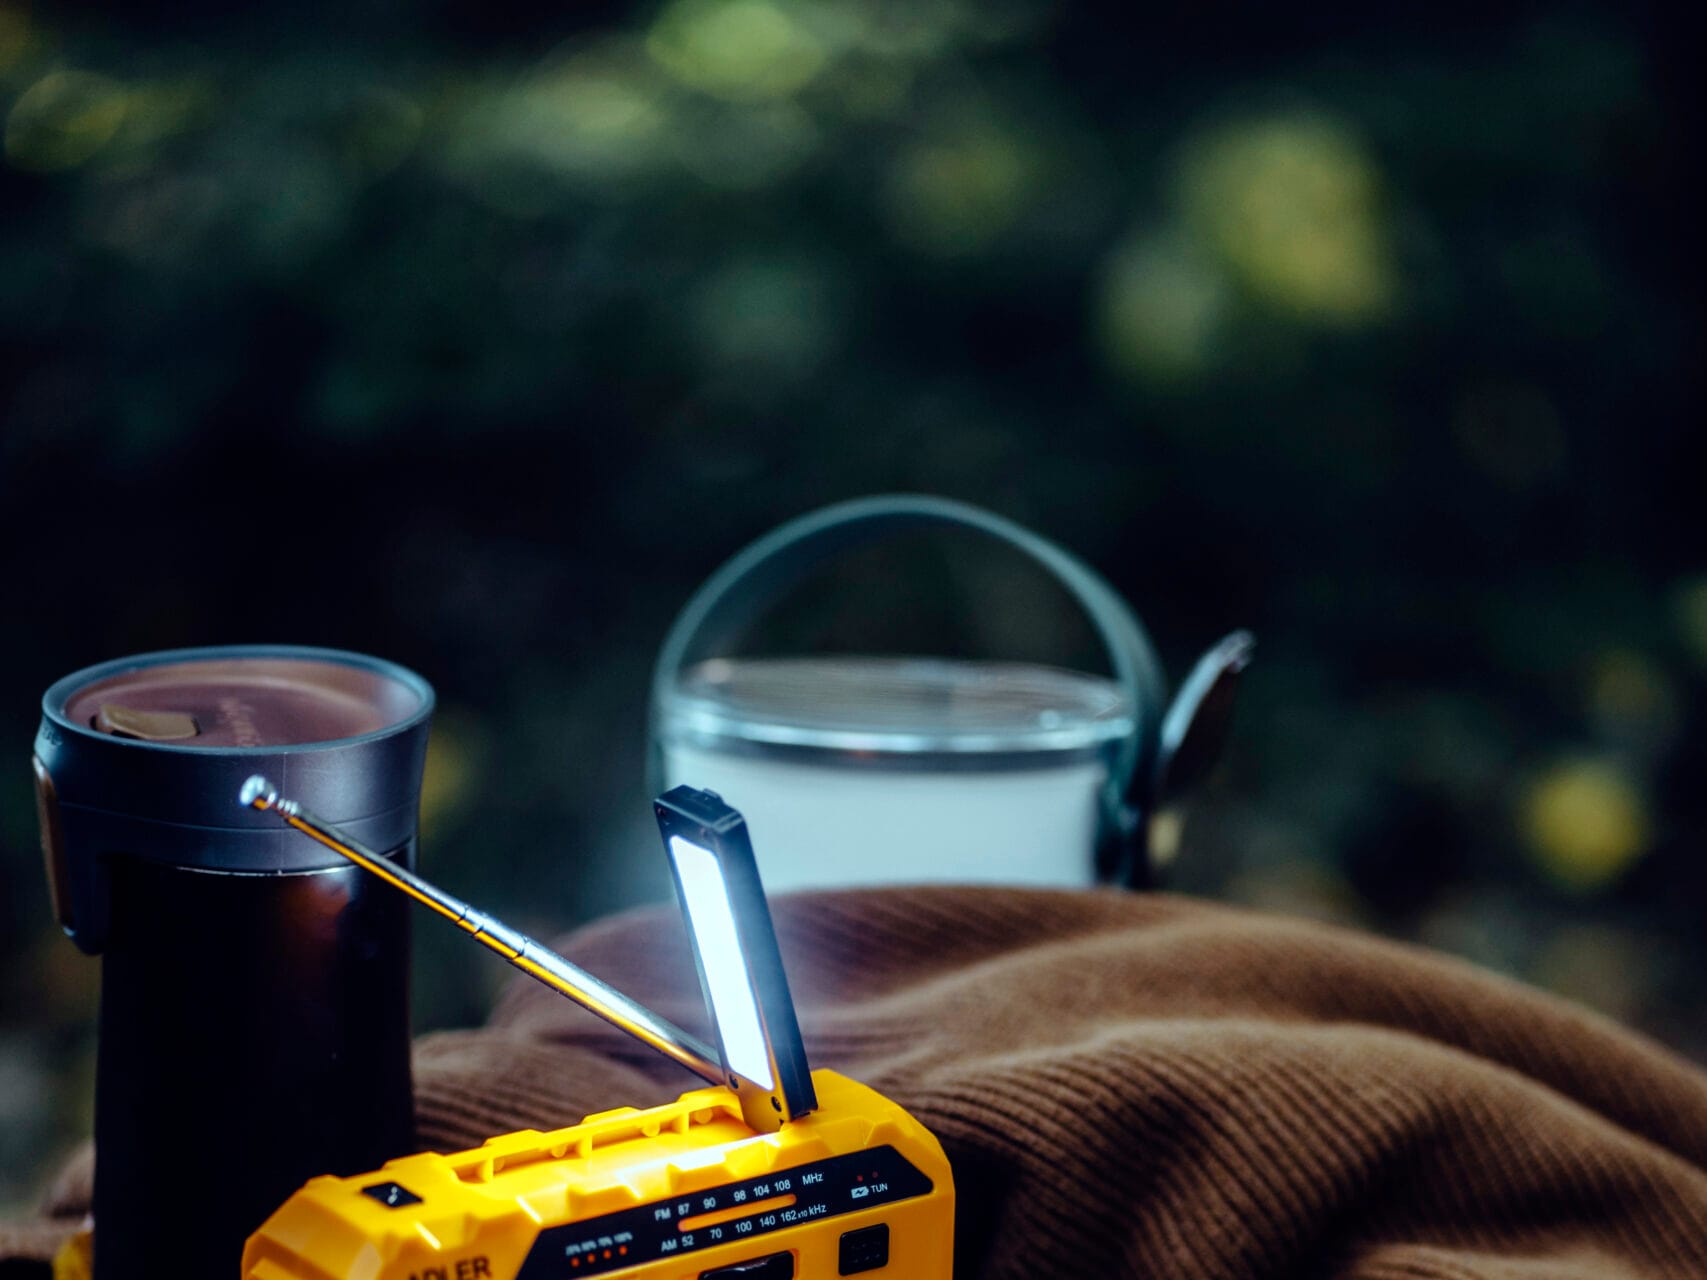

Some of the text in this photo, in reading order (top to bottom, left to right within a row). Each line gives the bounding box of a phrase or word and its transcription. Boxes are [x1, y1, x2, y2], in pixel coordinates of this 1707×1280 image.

[654, 1172, 824, 1221] FM 87 90 98 104 108 MHz
[870, 1183, 888, 1193] TUN
[661, 1239, 678, 1252] AM
[682, 1234, 695, 1247] 52
[709, 1228, 722, 1239] 70
[735, 1221, 752, 1233] 100
[760, 1215, 776, 1228] 140
[808, 1204, 827, 1216] kHz
